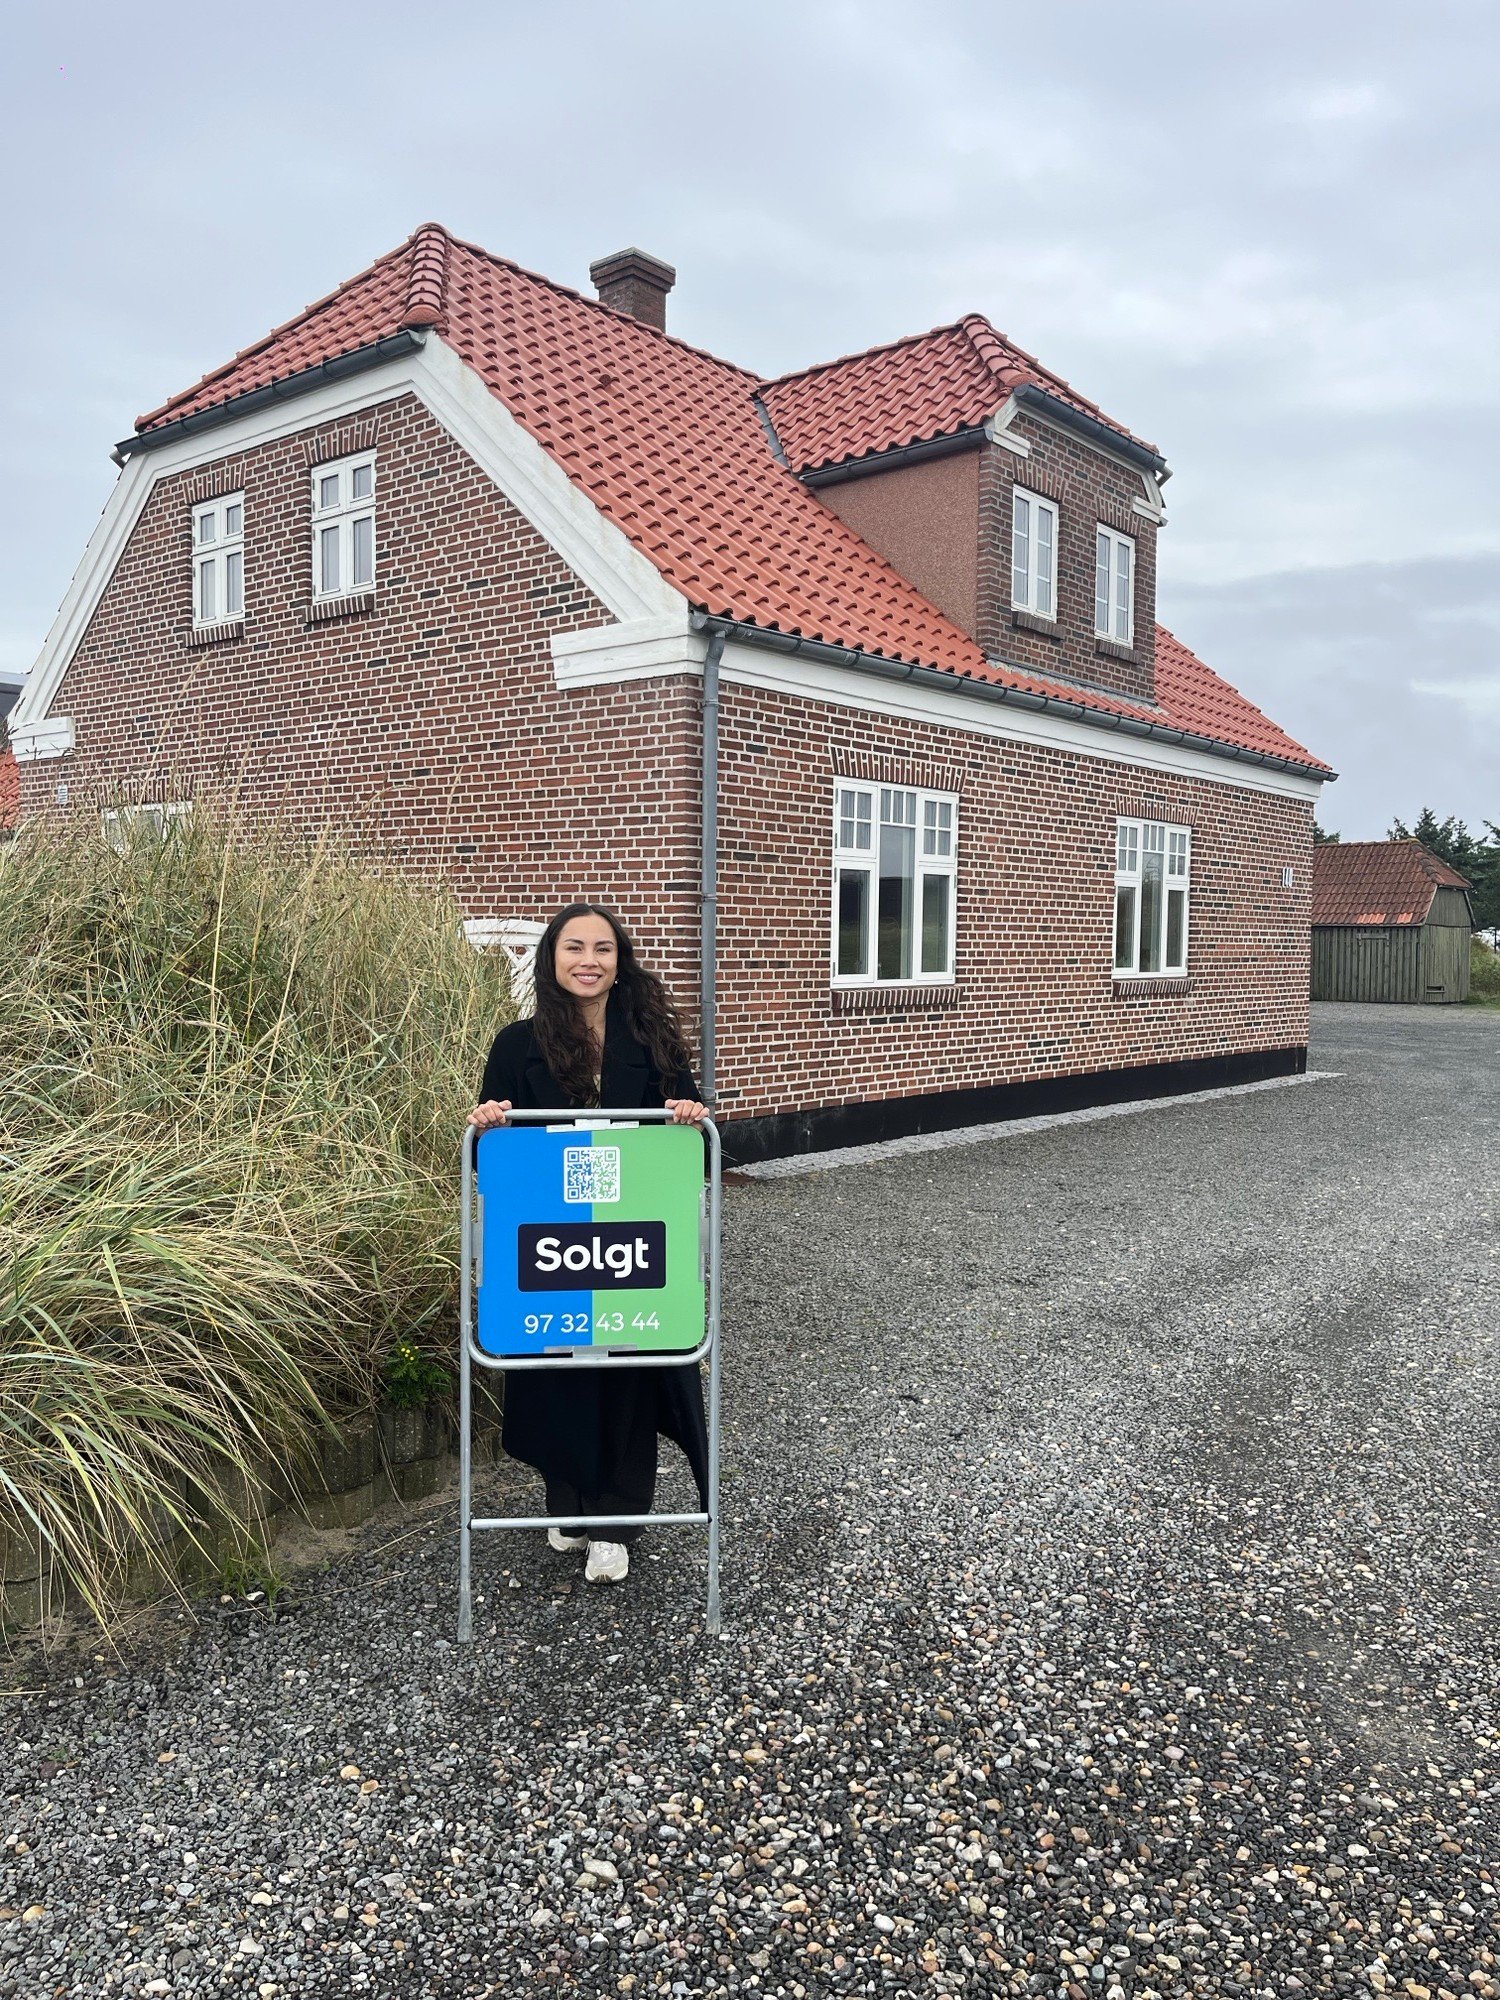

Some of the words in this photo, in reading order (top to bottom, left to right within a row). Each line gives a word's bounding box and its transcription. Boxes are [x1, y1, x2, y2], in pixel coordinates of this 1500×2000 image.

[534, 1236, 649, 1279] Solgt
[524, 1314, 554, 1334] 97
[560, 1313, 589, 1333] 32
[595, 1312, 625, 1332] 43
[631, 1311, 660, 1331] 44
